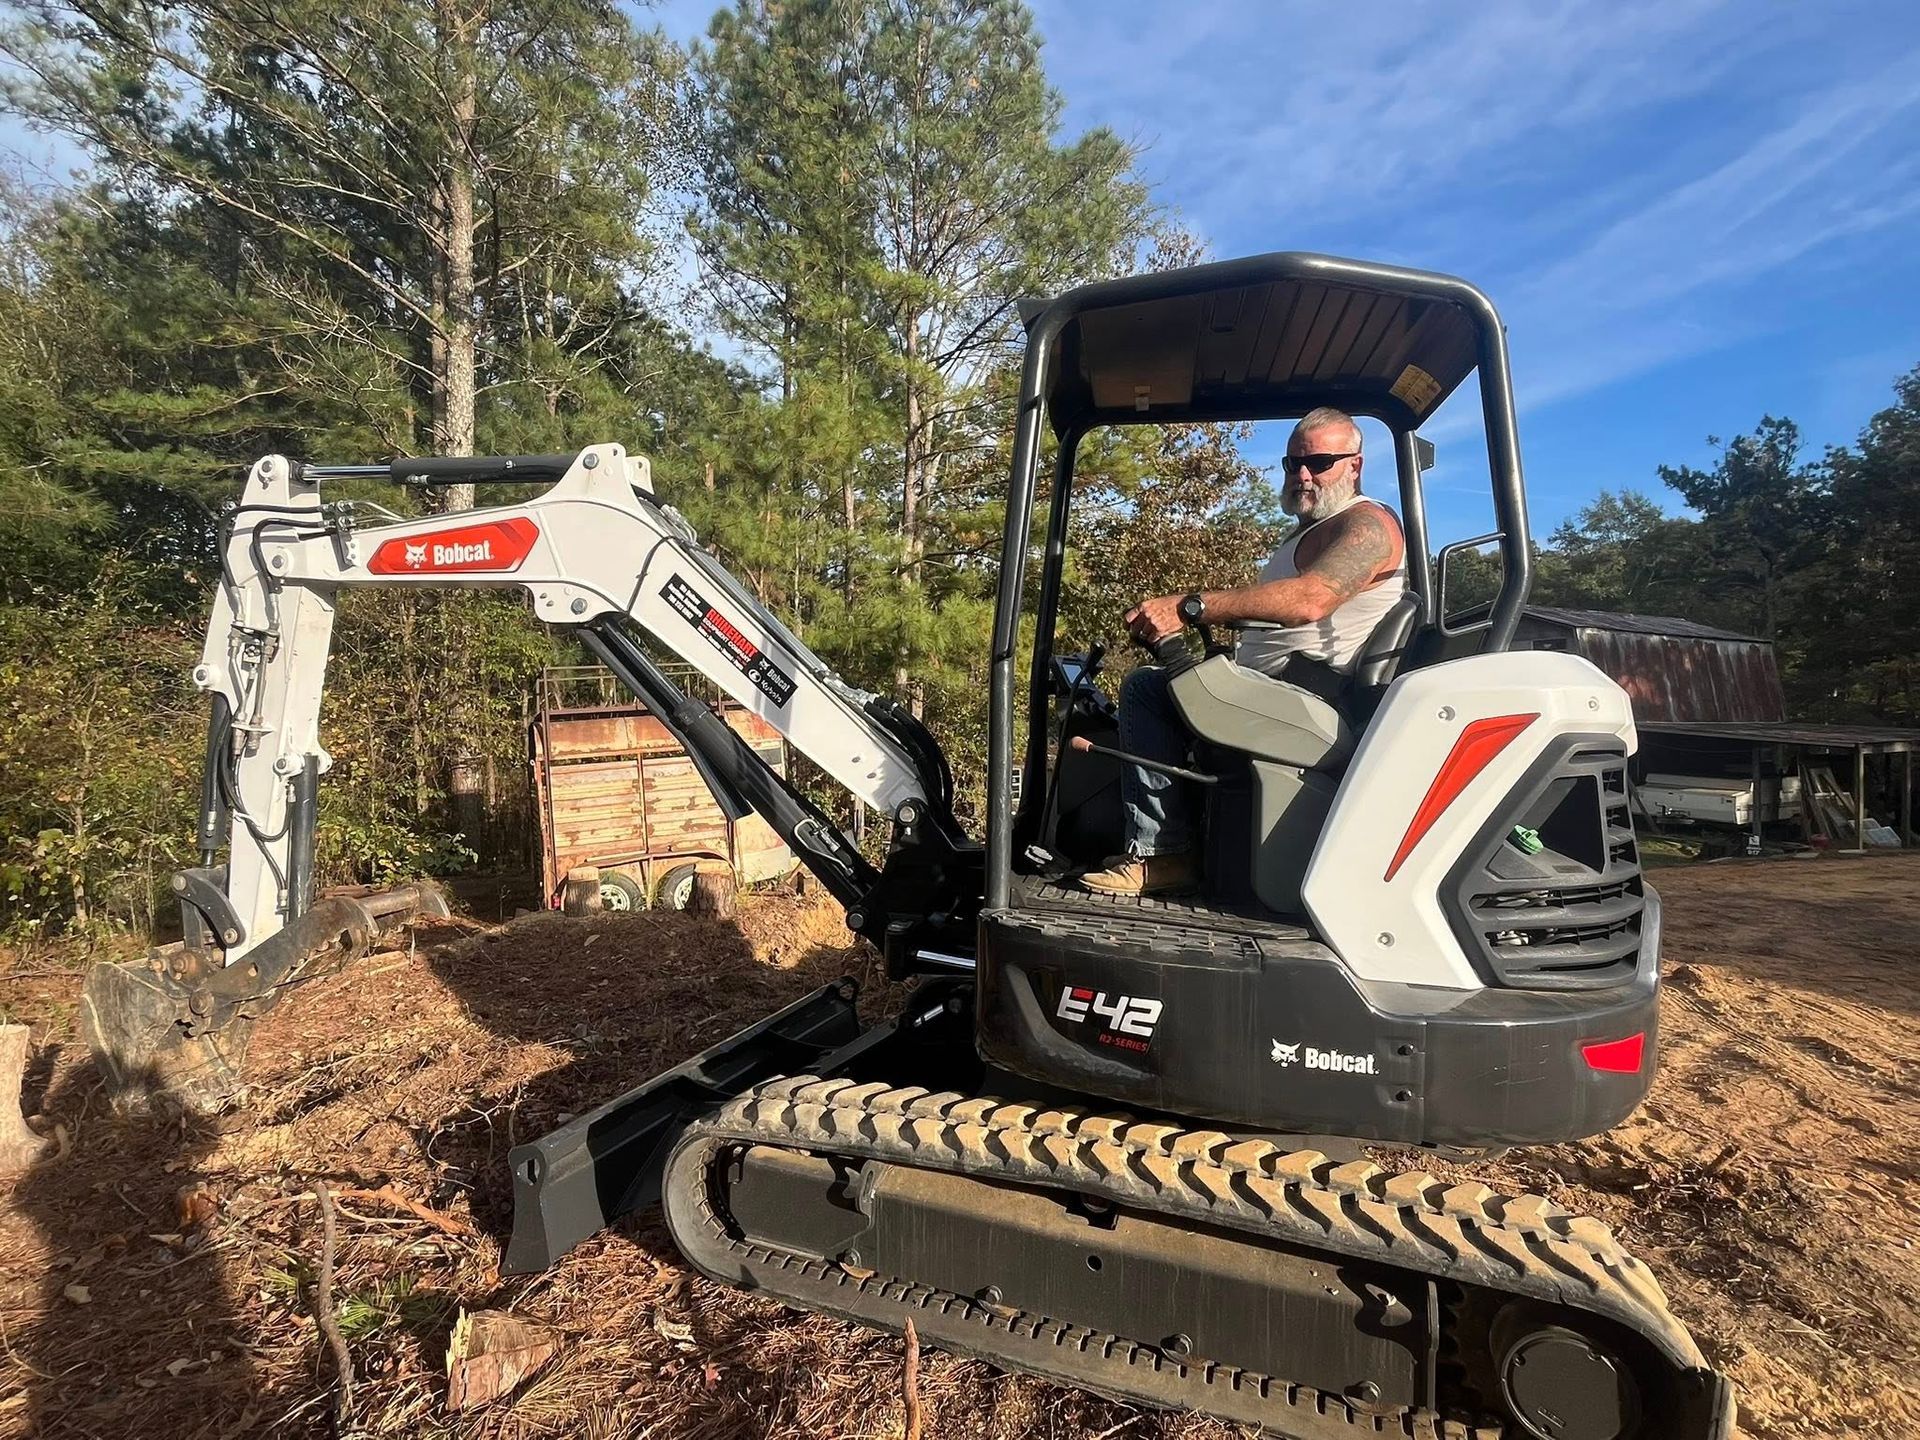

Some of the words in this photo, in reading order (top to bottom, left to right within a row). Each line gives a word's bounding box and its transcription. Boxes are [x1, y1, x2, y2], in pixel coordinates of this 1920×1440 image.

[433, 540, 491, 566] Bobcat
[706, 608, 757, 658] RHINEHART
[766, 667, 791, 692] Bobcat
[1057, 986, 1164, 1036] E42
[1305, 1047, 1376, 1074] Bobcat
